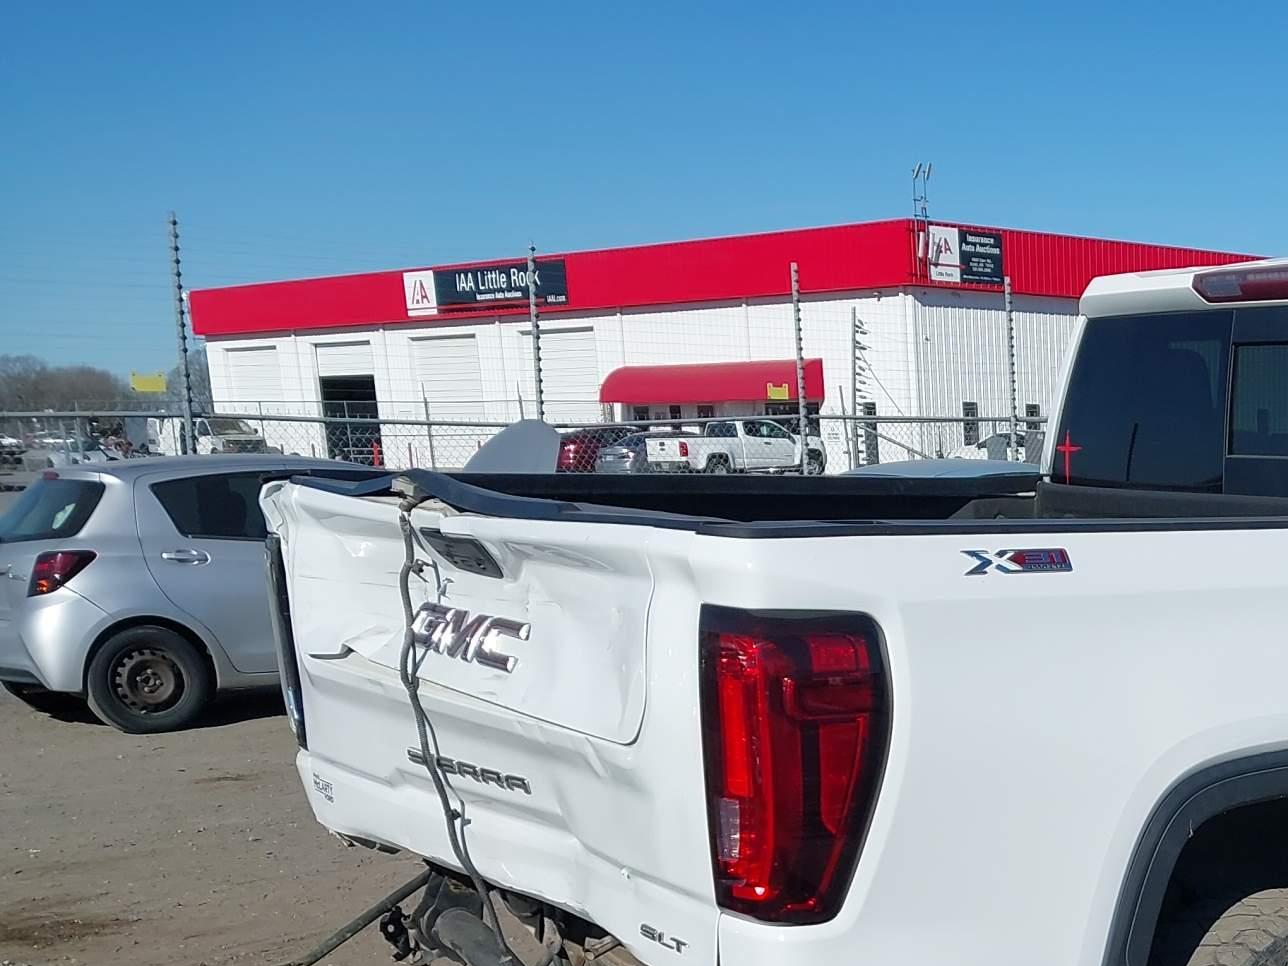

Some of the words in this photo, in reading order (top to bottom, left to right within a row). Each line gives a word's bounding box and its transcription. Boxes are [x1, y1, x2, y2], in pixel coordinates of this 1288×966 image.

[961, 242, 975, 252] Auto
[975, 243, 1000, 255] Auctions
[456, 272, 476, 292] IAA
[477, 269, 507, 290] Little
[411, 601, 532, 674] GMC
[406, 746, 532, 796] SERRA
[639, 923, 689, 954] SLT
